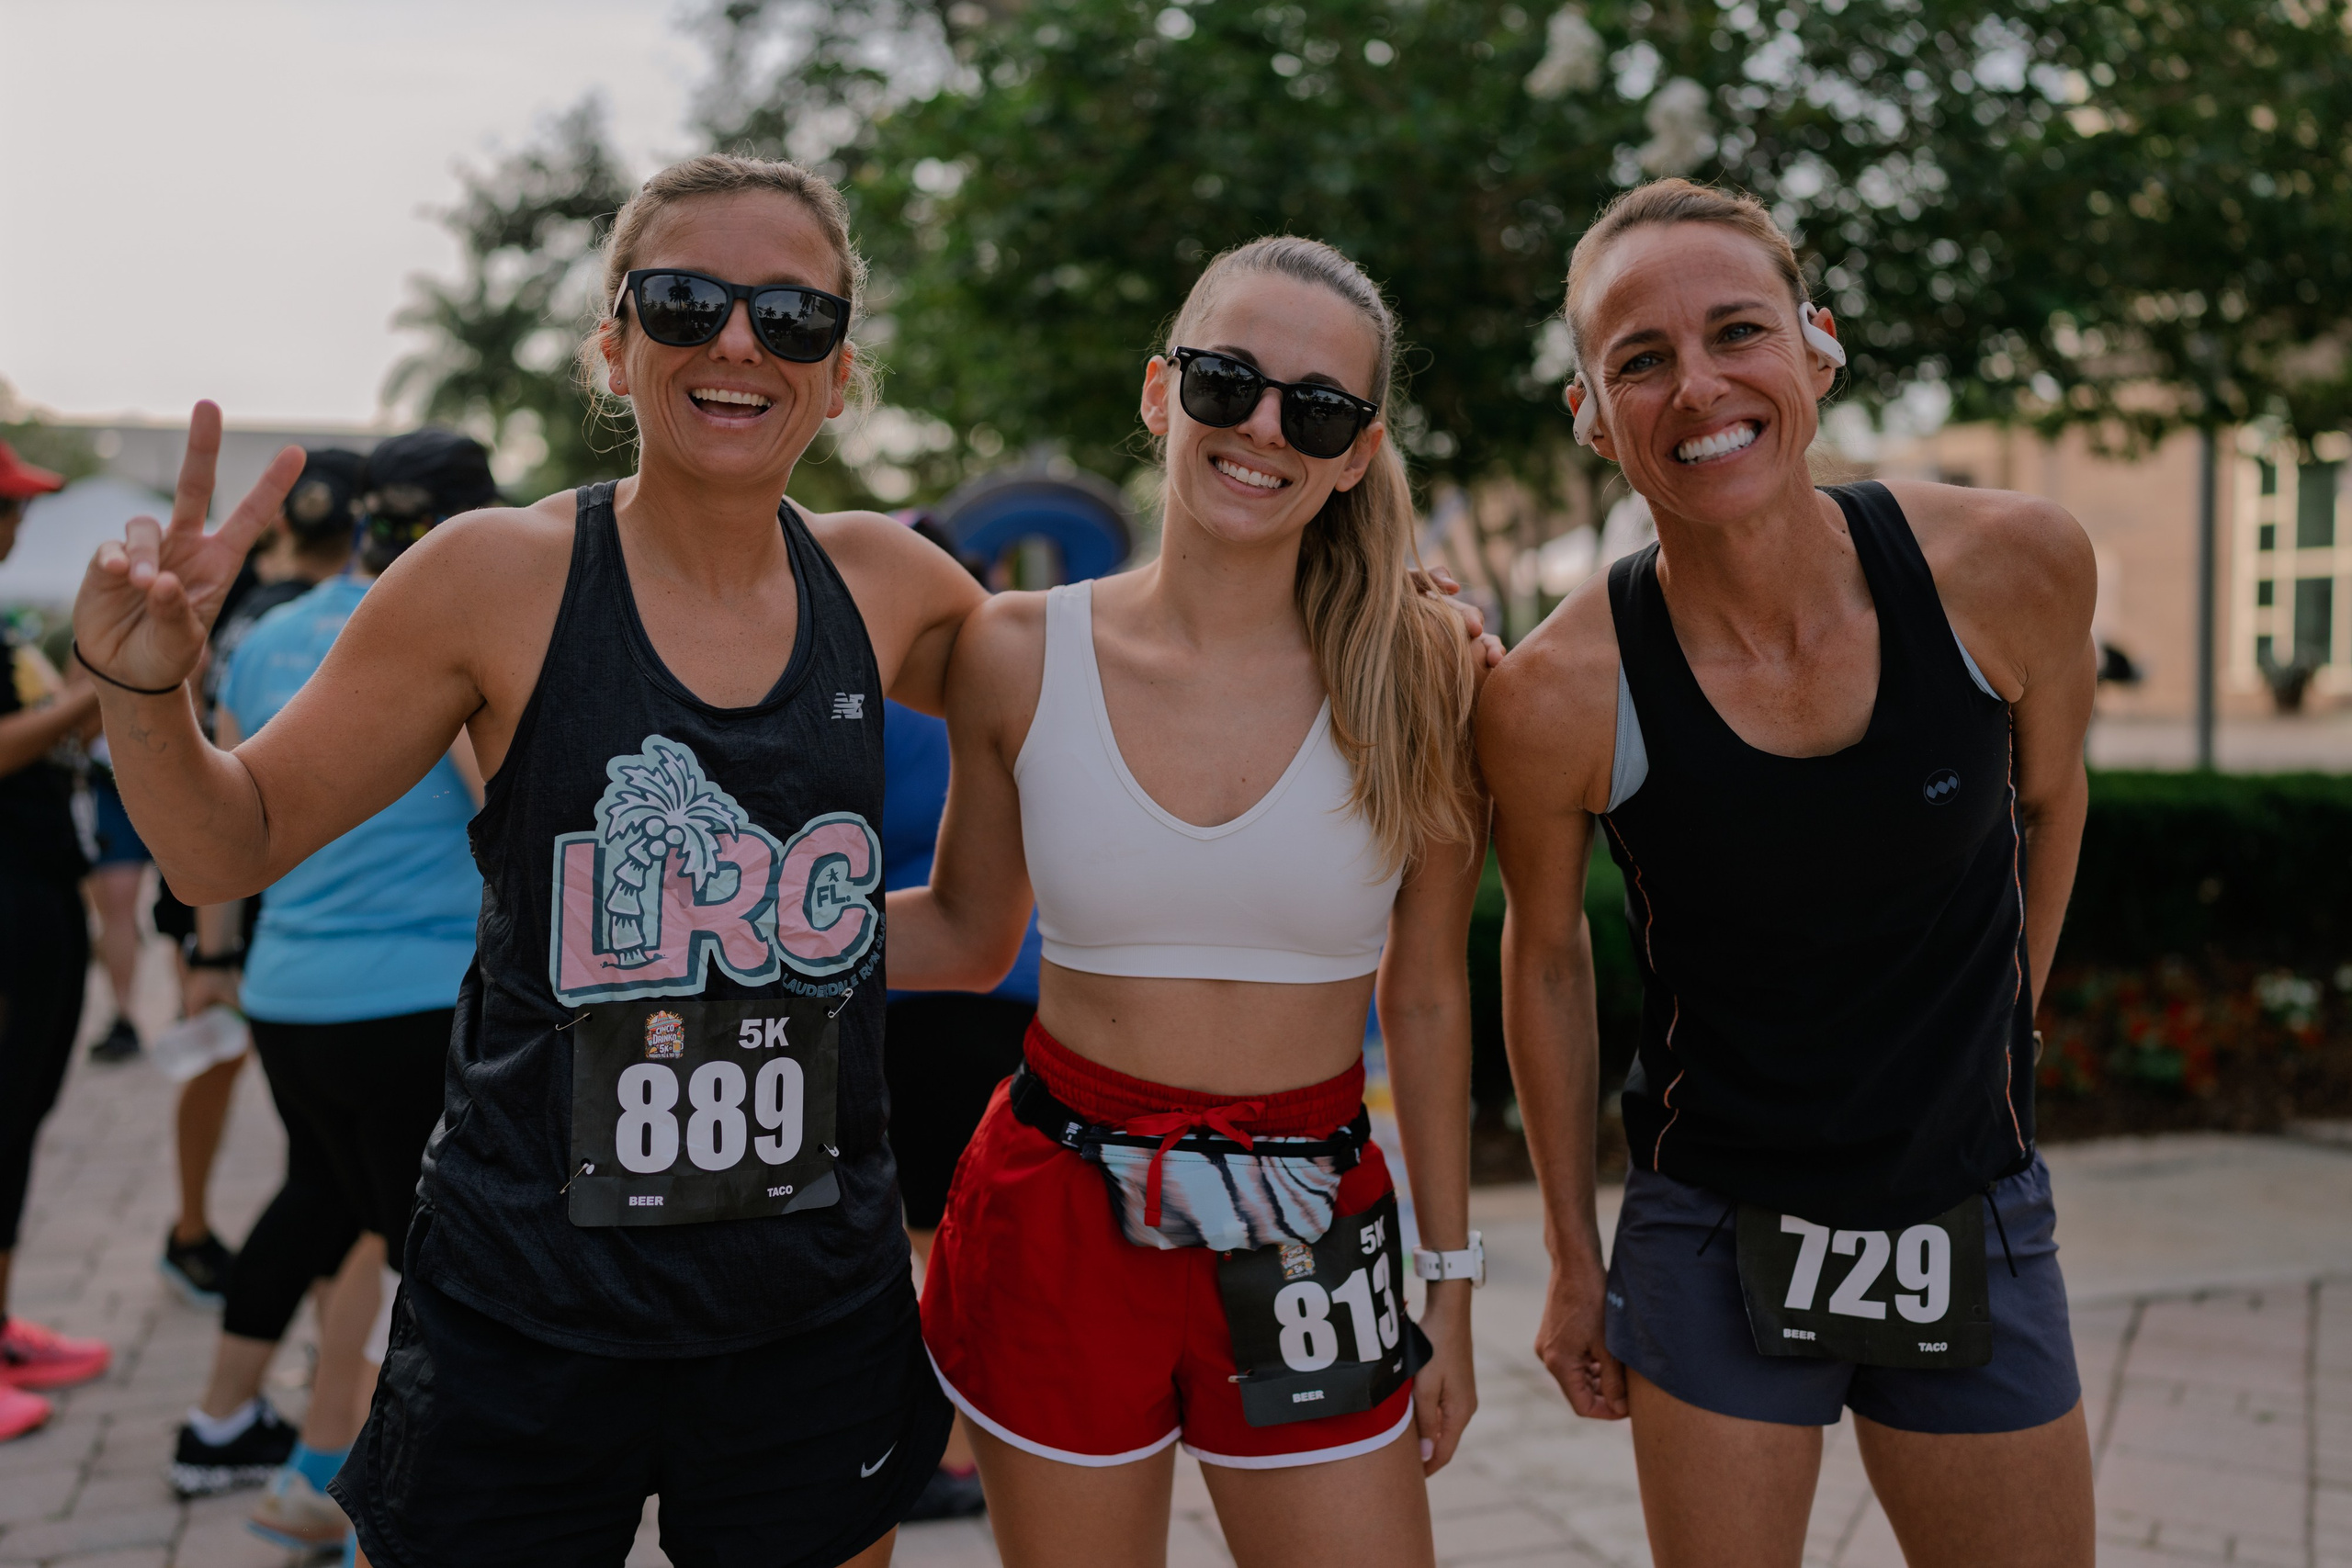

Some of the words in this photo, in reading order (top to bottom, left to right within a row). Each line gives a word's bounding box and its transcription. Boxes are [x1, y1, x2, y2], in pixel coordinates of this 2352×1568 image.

[556, 818, 876, 998] LRC
[816, 884, 852, 908] FL.
[782, 973, 860, 998] LAUDERDALE
[858, 950, 881, 981] RUN
[738, 1016, 790, 1049] 5K
[616, 1056, 804, 1174] 889
[628, 1195, 664, 1206] BEER
[767, 1185, 794, 1198] TACO
[1360, 1214, 1386, 1256] 5K
[1780, 1213, 1951, 1324] 729
[1273, 1252, 1399, 1372] 813
[1783, 1328, 1816, 1341] BEER
[1918, 1342, 1948, 1353] TACO
[1292, 1390, 1325, 1404] BEER
